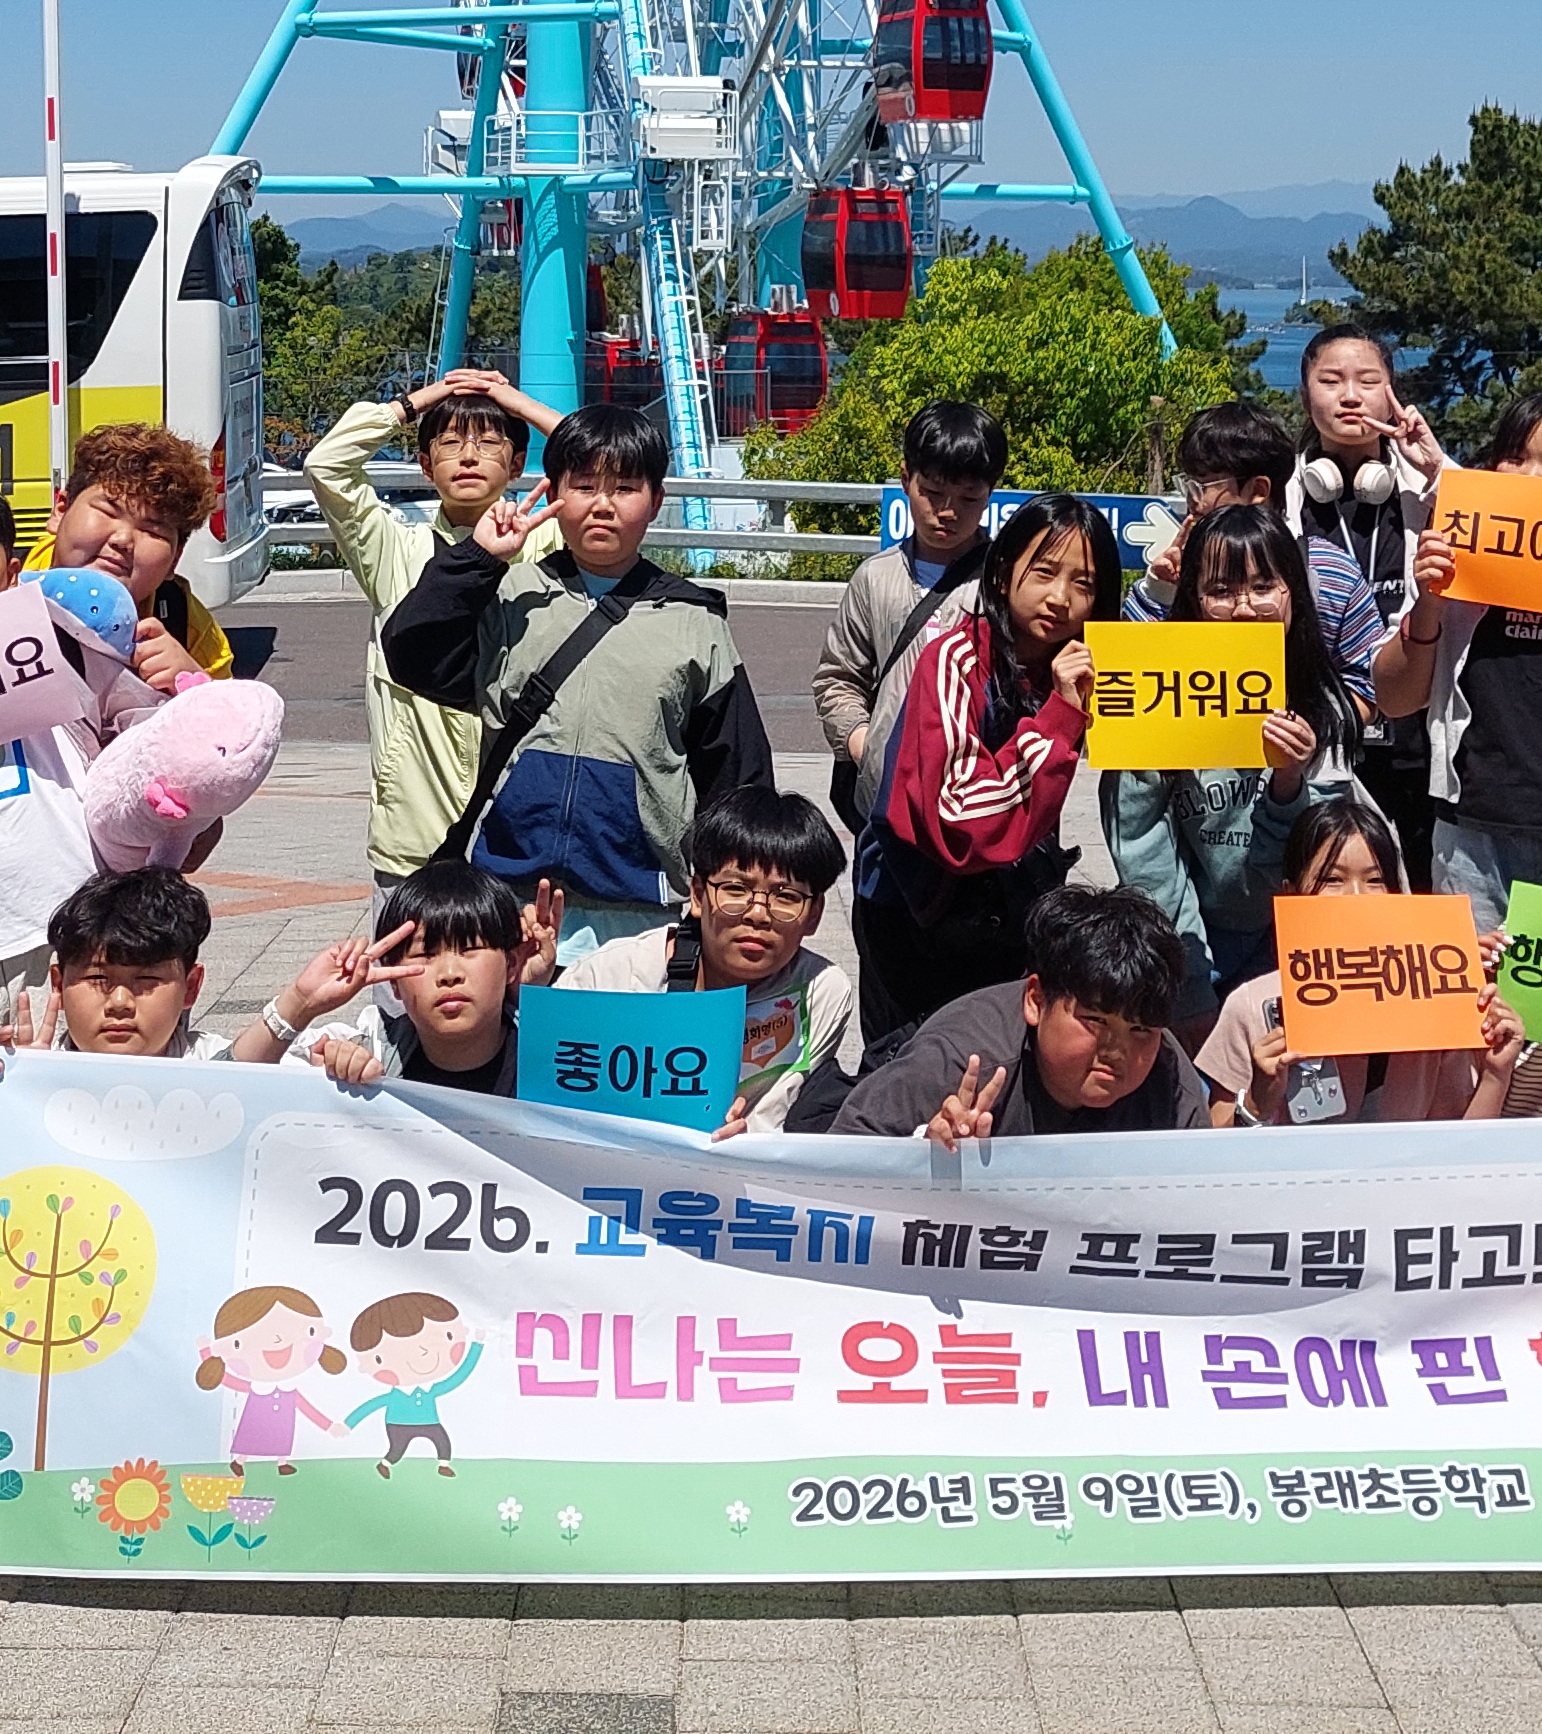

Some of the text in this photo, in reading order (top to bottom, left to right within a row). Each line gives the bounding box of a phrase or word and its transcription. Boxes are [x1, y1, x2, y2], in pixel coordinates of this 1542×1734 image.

[1095, 670, 1275, 718] 즐거워요
[1289, 943, 1478, 1007] 행복해요
[554, 1041, 709, 1099] 좋아요
[314, 1176, 549, 1254] 2026.
[575, 1186, 876, 1266] 교육복지
[901, 1219, 1049, 1272] 체험
[1068, 1229, 1367, 1290] 프로그램
[515, 1311, 801, 1404] 신나는
[836, 1320, 1049, 1408] 오늘,
[1076, 1329, 1170, 1409] 내
[1201, 1334, 1388, 1410] 손에
[1410, 1335, 1509, 1406] 핀
[792, 1464, 1532, 1524] 2026년 5월 9일(토), 봉래초등학교
